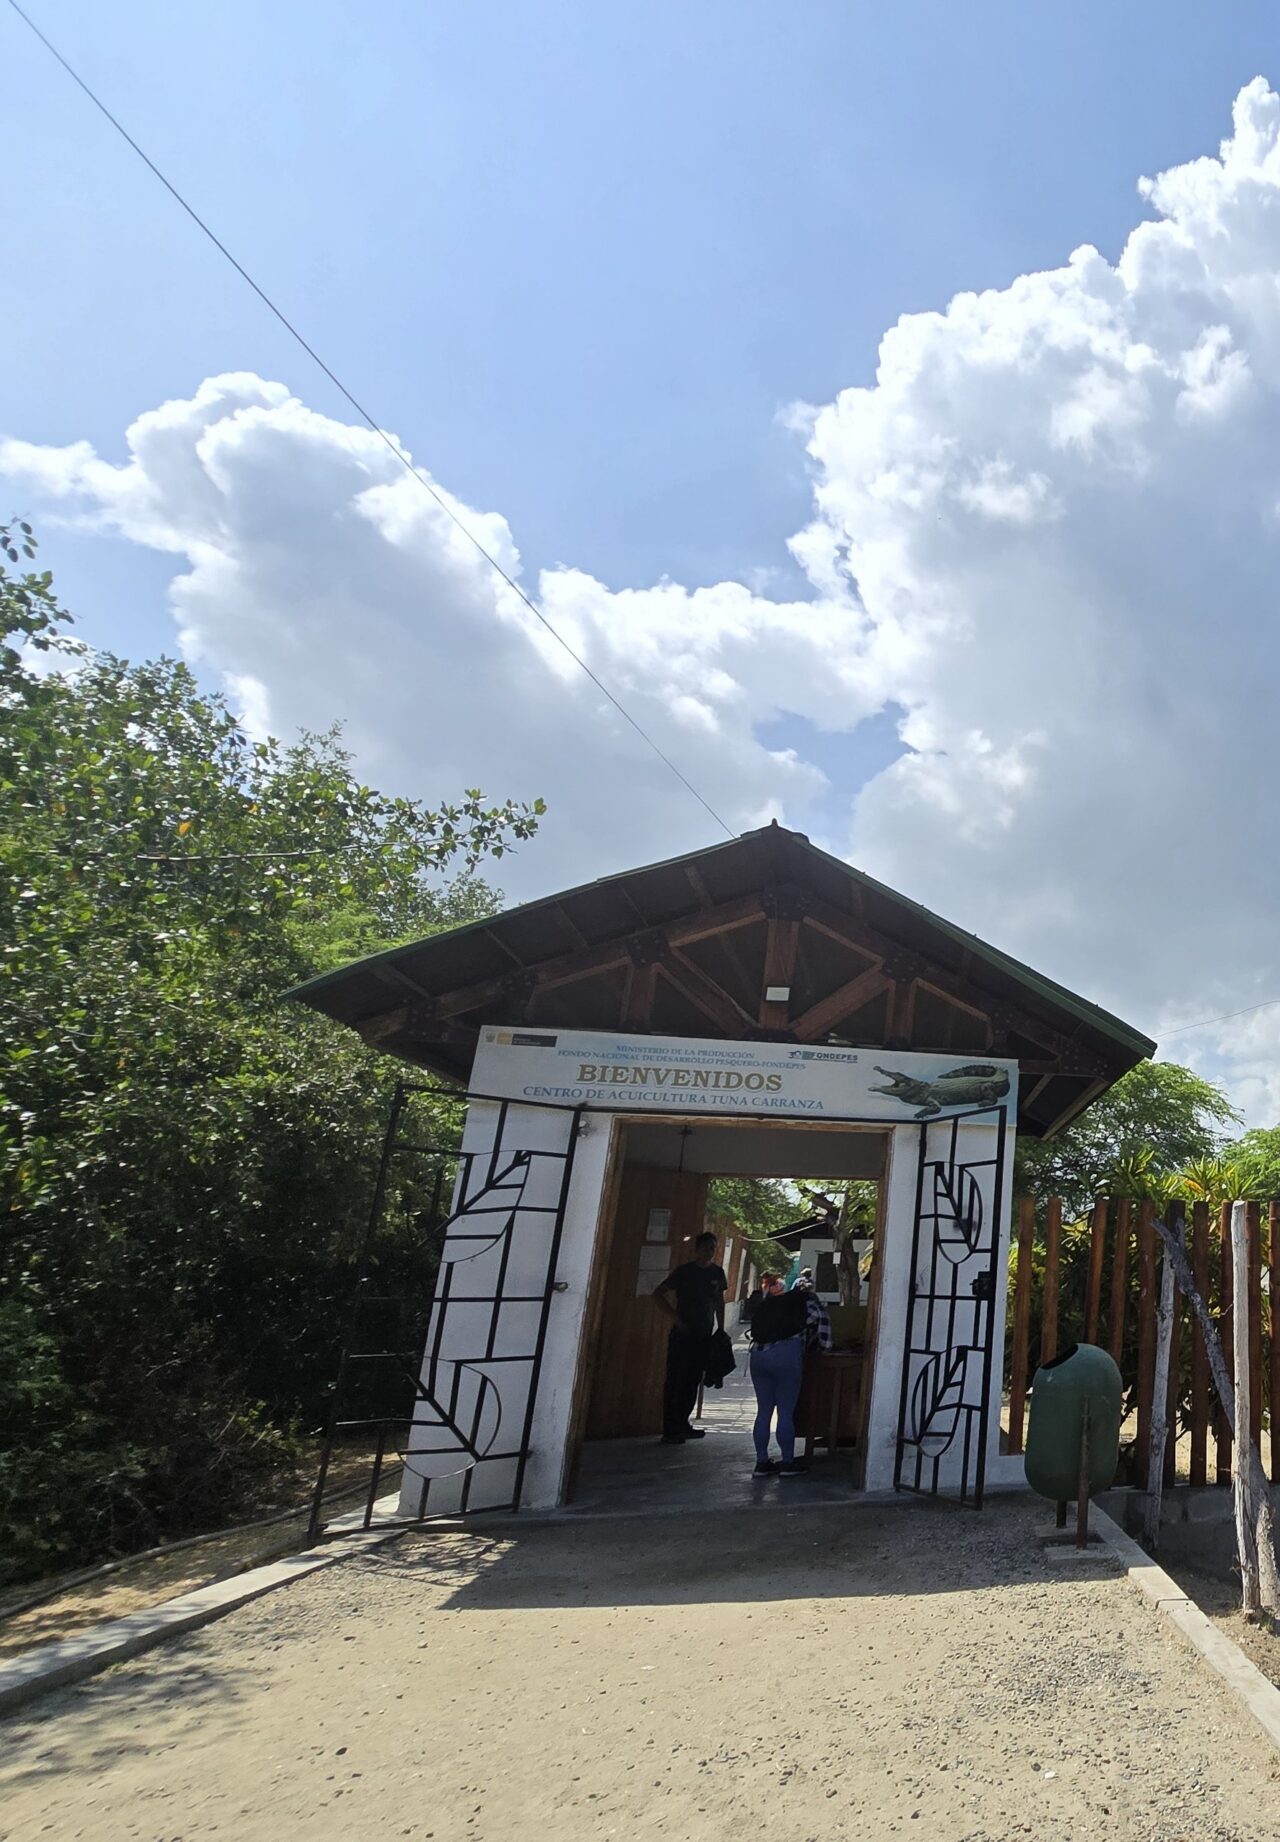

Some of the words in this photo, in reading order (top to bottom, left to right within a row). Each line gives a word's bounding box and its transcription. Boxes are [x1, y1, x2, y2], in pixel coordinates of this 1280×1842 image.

[558, 1050, 592, 1058] FONDO
[592, 1052, 641, 1061] NACIONAL
[656, 1055, 714, 1065] DESARROLLO
[616, 1045, 670, 1055] MINISTERIO
[671, 1048, 683, 1056] DE
[684, 1048, 697, 1056] LA
[697, 1048, 755, 1060] PRODUCCIÓN
[576, 1063, 783, 1092] BIENVENIDOS
[522, 1085, 583, 1099] CENTRO
[585, 1088, 605, 1099] DE
[607, 1089, 706, 1104] ACUICULTURA
[710, 1094, 748, 1106] TUNA
[752, 1096, 824, 1110] CARRANZA
